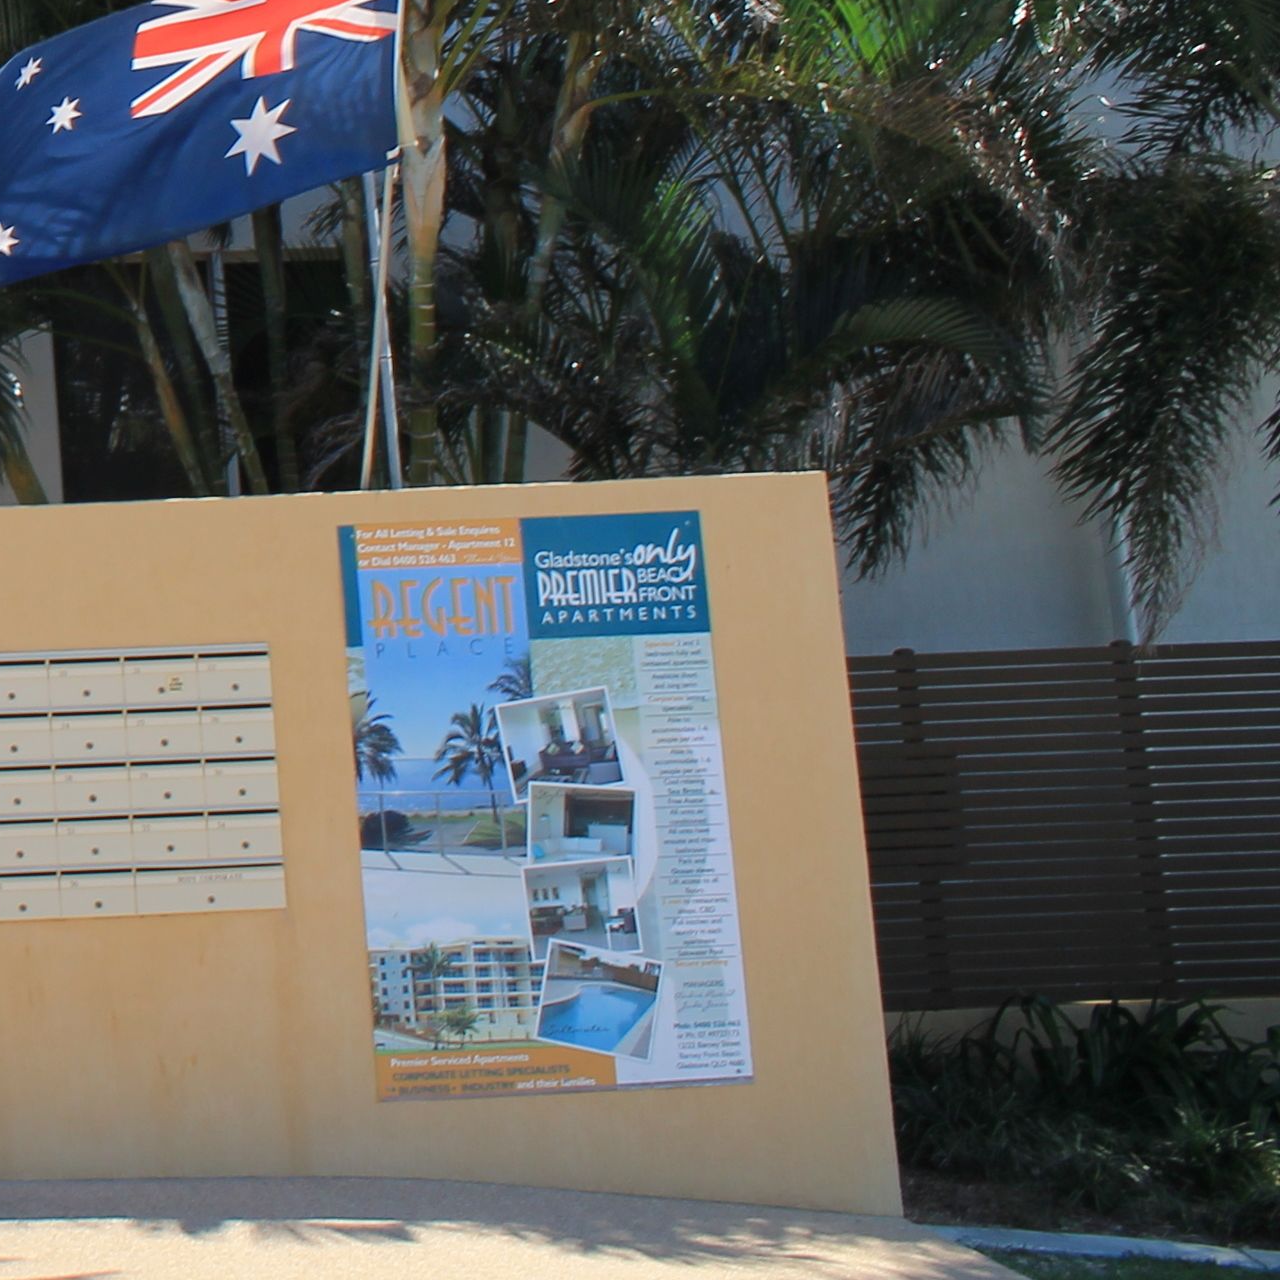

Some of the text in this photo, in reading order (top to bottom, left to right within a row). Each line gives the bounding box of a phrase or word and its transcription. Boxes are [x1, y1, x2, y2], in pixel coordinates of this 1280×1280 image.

[356, 530, 373, 539] For
[357, 542, 395, 553] Contact
[398, 541, 440, 553] Manager
[448, 539, 501, 551] Apartment
[504, 537, 516, 548] 12
[371, 556, 391, 566] Dial
[534, 527, 696, 583] Gladstone's only
[637, 566, 694, 584] BEACH
[536, 567, 638, 607] PREMIER
[639, 585, 697, 602] FRONT
[368, 576, 516, 638] REGENT
[541, 605, 697, 625] APARTMENTS
[376, 637, 513, 658] PLACE
[391, 1053, 529, 1067] Premier Serviced Apartments
[392, 1070, 456, 1081] CORPORATE
[517, 1080, 535, 1089] and
[536, 1078, 558, 1088] their
[559, 1076, 596, 1087] families
